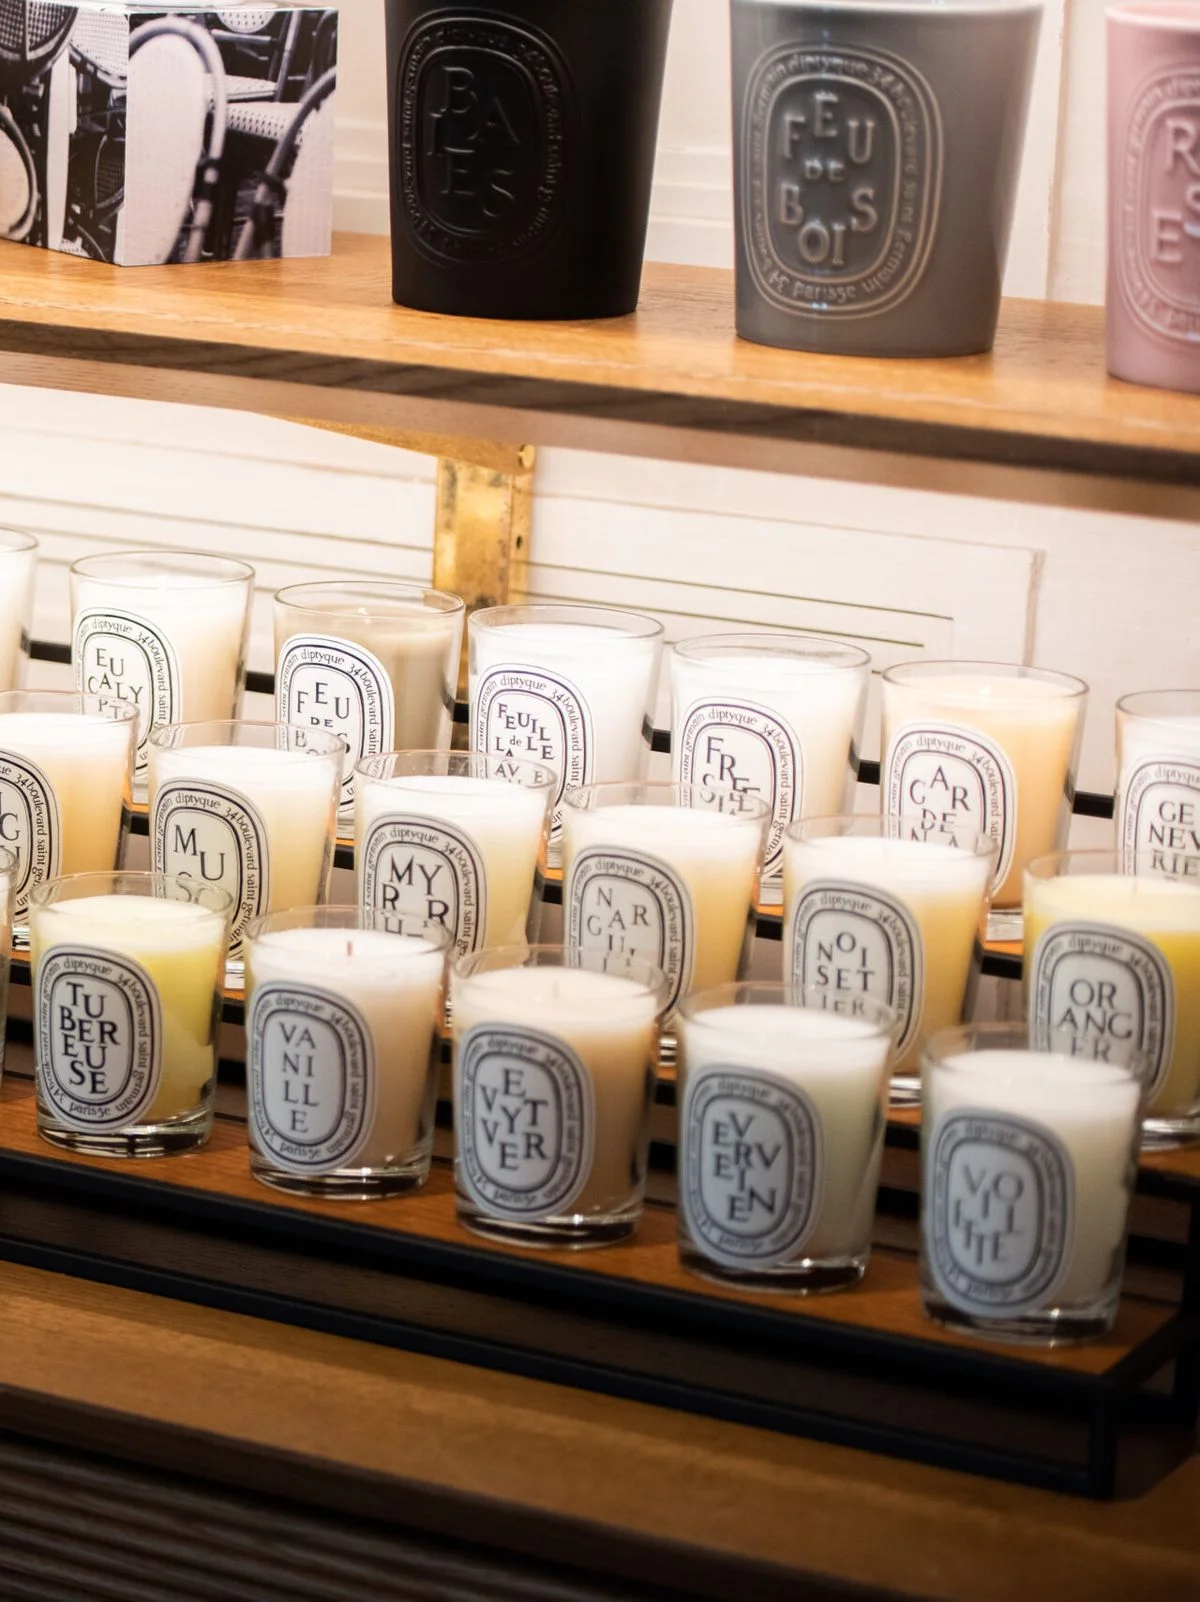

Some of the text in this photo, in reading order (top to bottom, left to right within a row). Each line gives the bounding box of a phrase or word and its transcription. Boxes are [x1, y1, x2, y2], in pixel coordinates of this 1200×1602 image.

[782, 90, 875, 164] FEU
[804, 157, 845, 181] DE
[91, 619, 133, 634] diptyque
[96, 649, 125, 677] EU
[149, 640, 169, 692] boulevard
[158, 694, 167, 721] saint
[296, 682, 350, 719] FEU
[300, 648, 380, 756] diptyque 34 boulevard saint
[310, 717, 334, 728] DE
[500, 675, 583, 782] diptyque 34 boulevard saint
[509, 735, 523, 747] de
[14, 773, 30, 788] 34
[708, 708, 792, 822] diptyque 34 boulevard saint
[27, 781, 48, 837] boulevard
[1158, 800, 1195, 826] GE
[175, 792, 258, 901] diptyque 34 boulevard saint
[390, 827, 440, 844] diptyque
[36, 839, 49, 867] saint
[173, 824, 226, 882] MU
[388, 853, 444, 897] MY
[456, 850, 476, 907] boulevard
[463, 909, 475, 939] saint
[816, 931, 868, 968] NOI
[63, 956, 113, 976] diptyque
[816, 965, 875, 992] SET
[66, 981, 107, 1018] TU
[128, 979, 150, 1038] boulevard
[1069, 978, 1119, 1010] OR
[59, 1005, 121, 1046] BER
[278, 1021, 317, 1049] VA
[61, 1032, 107, 1070] EU
[137, 1040, 150, 1069] saint
[281, 1051, 316, 1078] NI
[69, 1059, 110, 1095] SE
[115, 1069, 146, 1113] germain
[282, 1079, 321, 1108] LL
[289, 1109, 309, 1133] E
